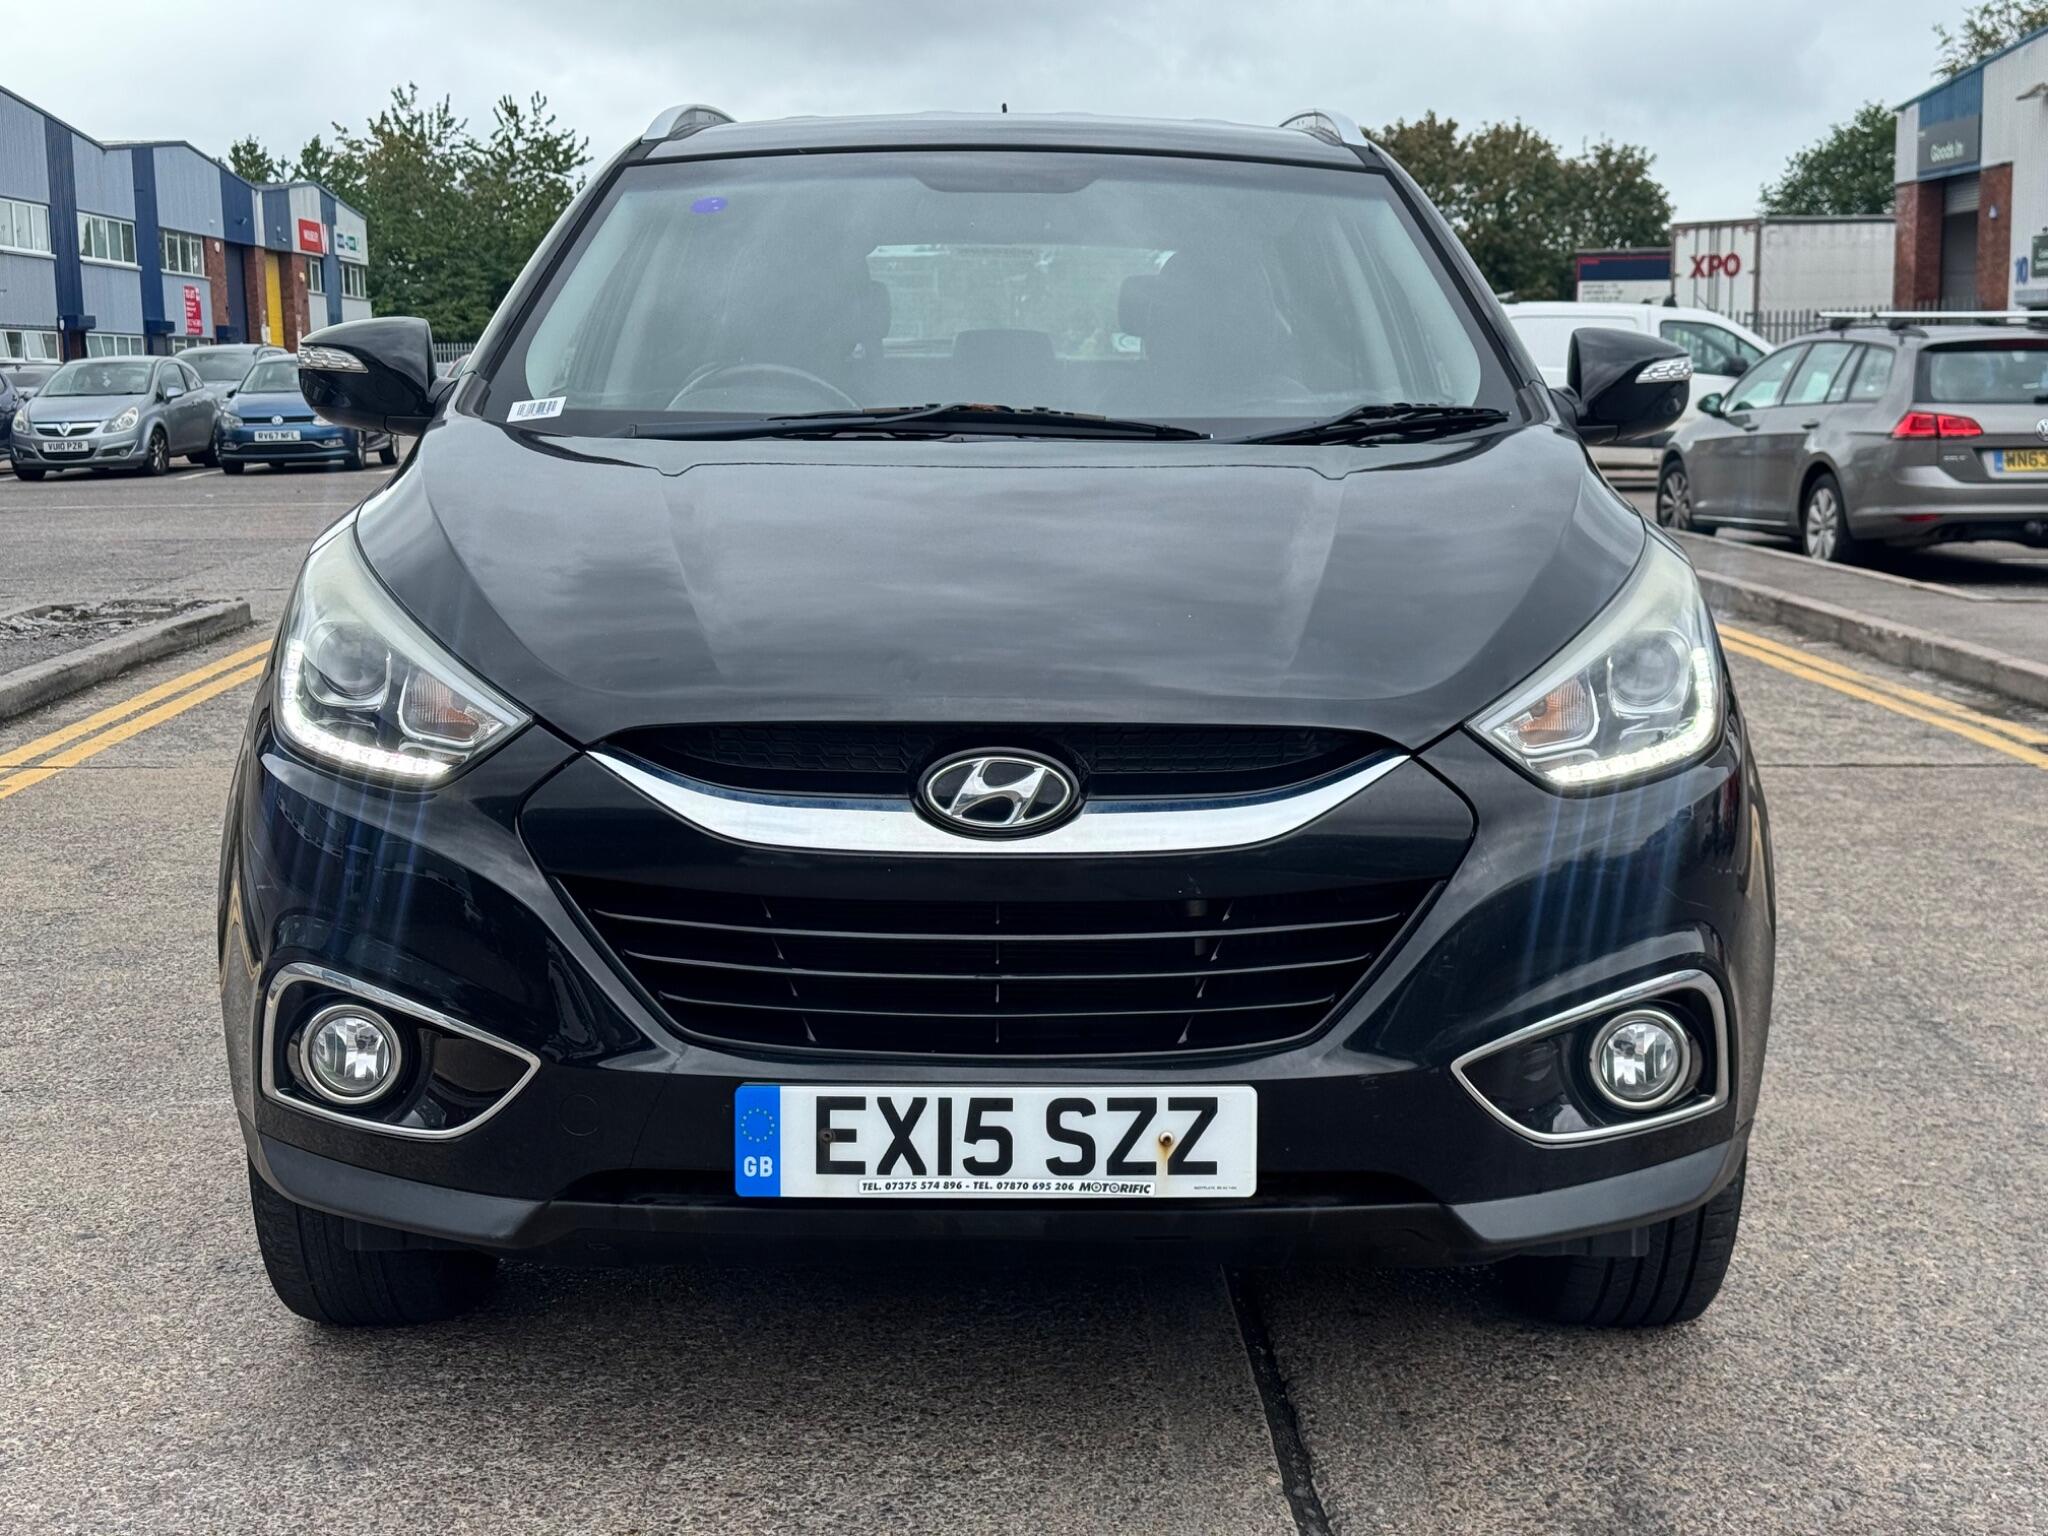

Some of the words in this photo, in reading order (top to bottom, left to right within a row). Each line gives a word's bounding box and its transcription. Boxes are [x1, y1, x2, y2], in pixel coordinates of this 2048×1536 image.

[1690, 252, 1741, 278] XPO
[2015, 256, 2028, 284] 10
[47, 442, 65, 451] VU10
[66, 441, 83, 450] PZR
[258, 431, 279, 440] RV67
[280, 431, 298, 440] NFL
[2005, 449, 2048, 469] WN63
[815, 1095, 1014, 1176] EX15
[1045, 1096, 1219, 1177] SZZ
[743, 1156, 774, 1178] GB
[862, 1182, 881, 1191] TEL.
[885, 1181, 917, 1191] 07375
[920, 1181, 940, 1190] 574
[943, 1181, 962, 1190] 896
[973, 1181, 993, 1190] TEL.
[996, 1181, 1029, 1190] 07870
[1032, 1182, 1051, 1190] 695
[1055, 1182, 1074, 1191] 206
[1079, 1182, 1151, 1194] MOTORIFIC
